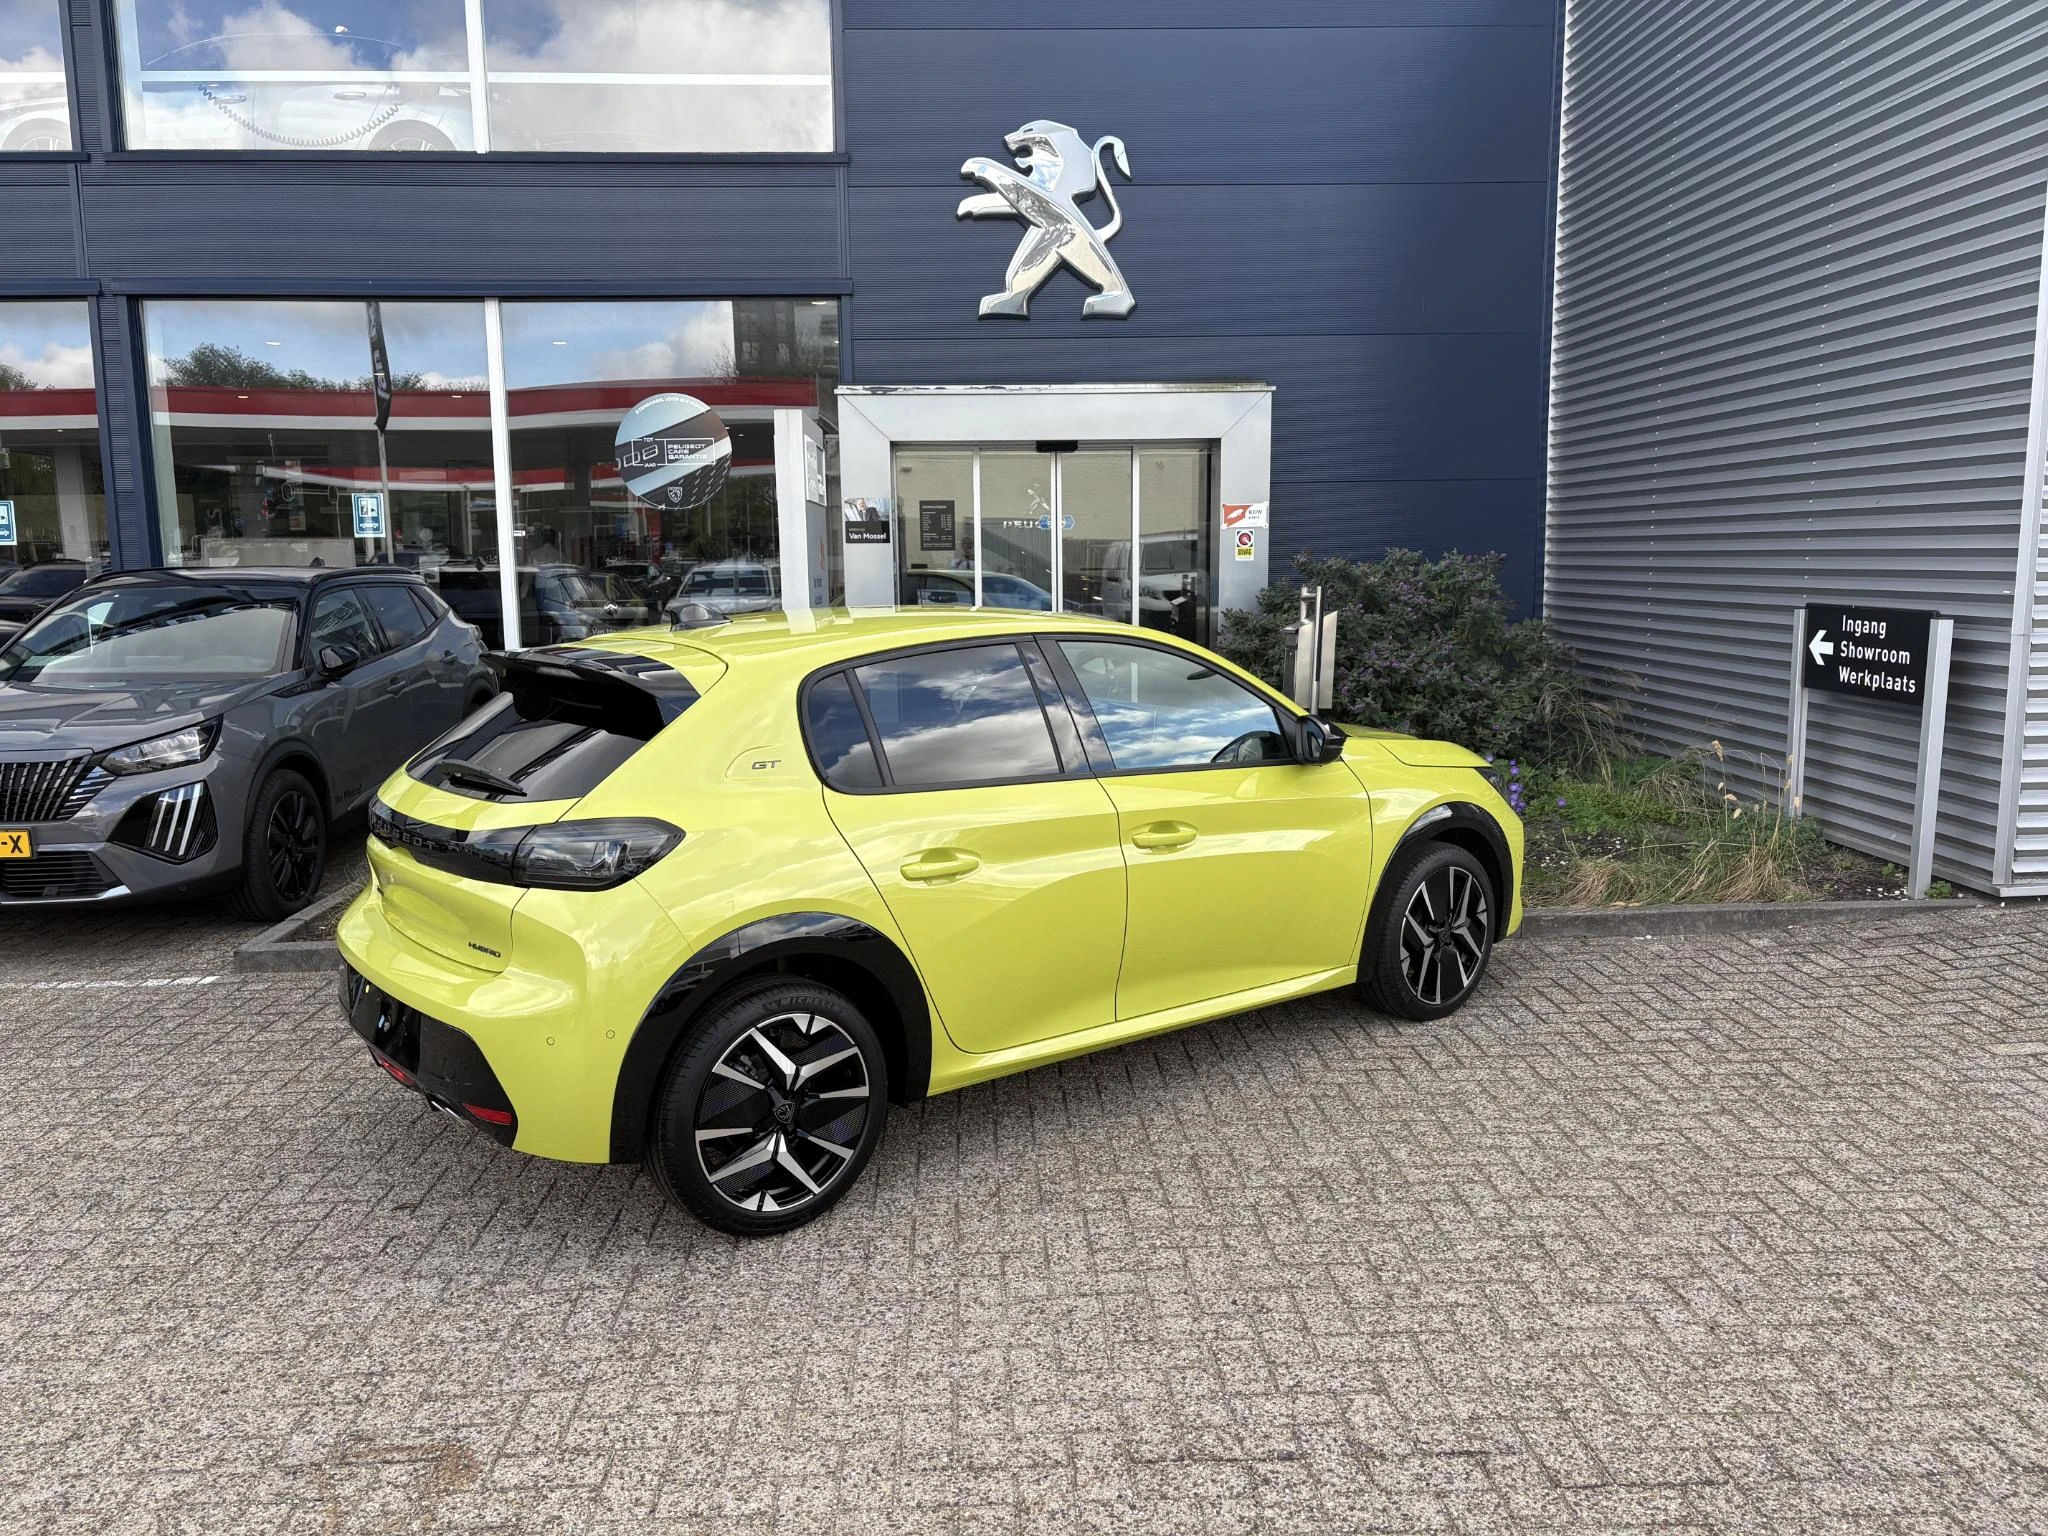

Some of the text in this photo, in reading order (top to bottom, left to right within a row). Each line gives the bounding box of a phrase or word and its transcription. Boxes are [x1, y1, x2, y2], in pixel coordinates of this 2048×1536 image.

[848, 532, 887, 540] Van Mossel
[1842, 614, 1887, 639] Ingang
[1840, 640, 1911, 665] Showroom
[1838, 665, 1916, 693] Werkplaats
[752, 759, 781, 770] GT
